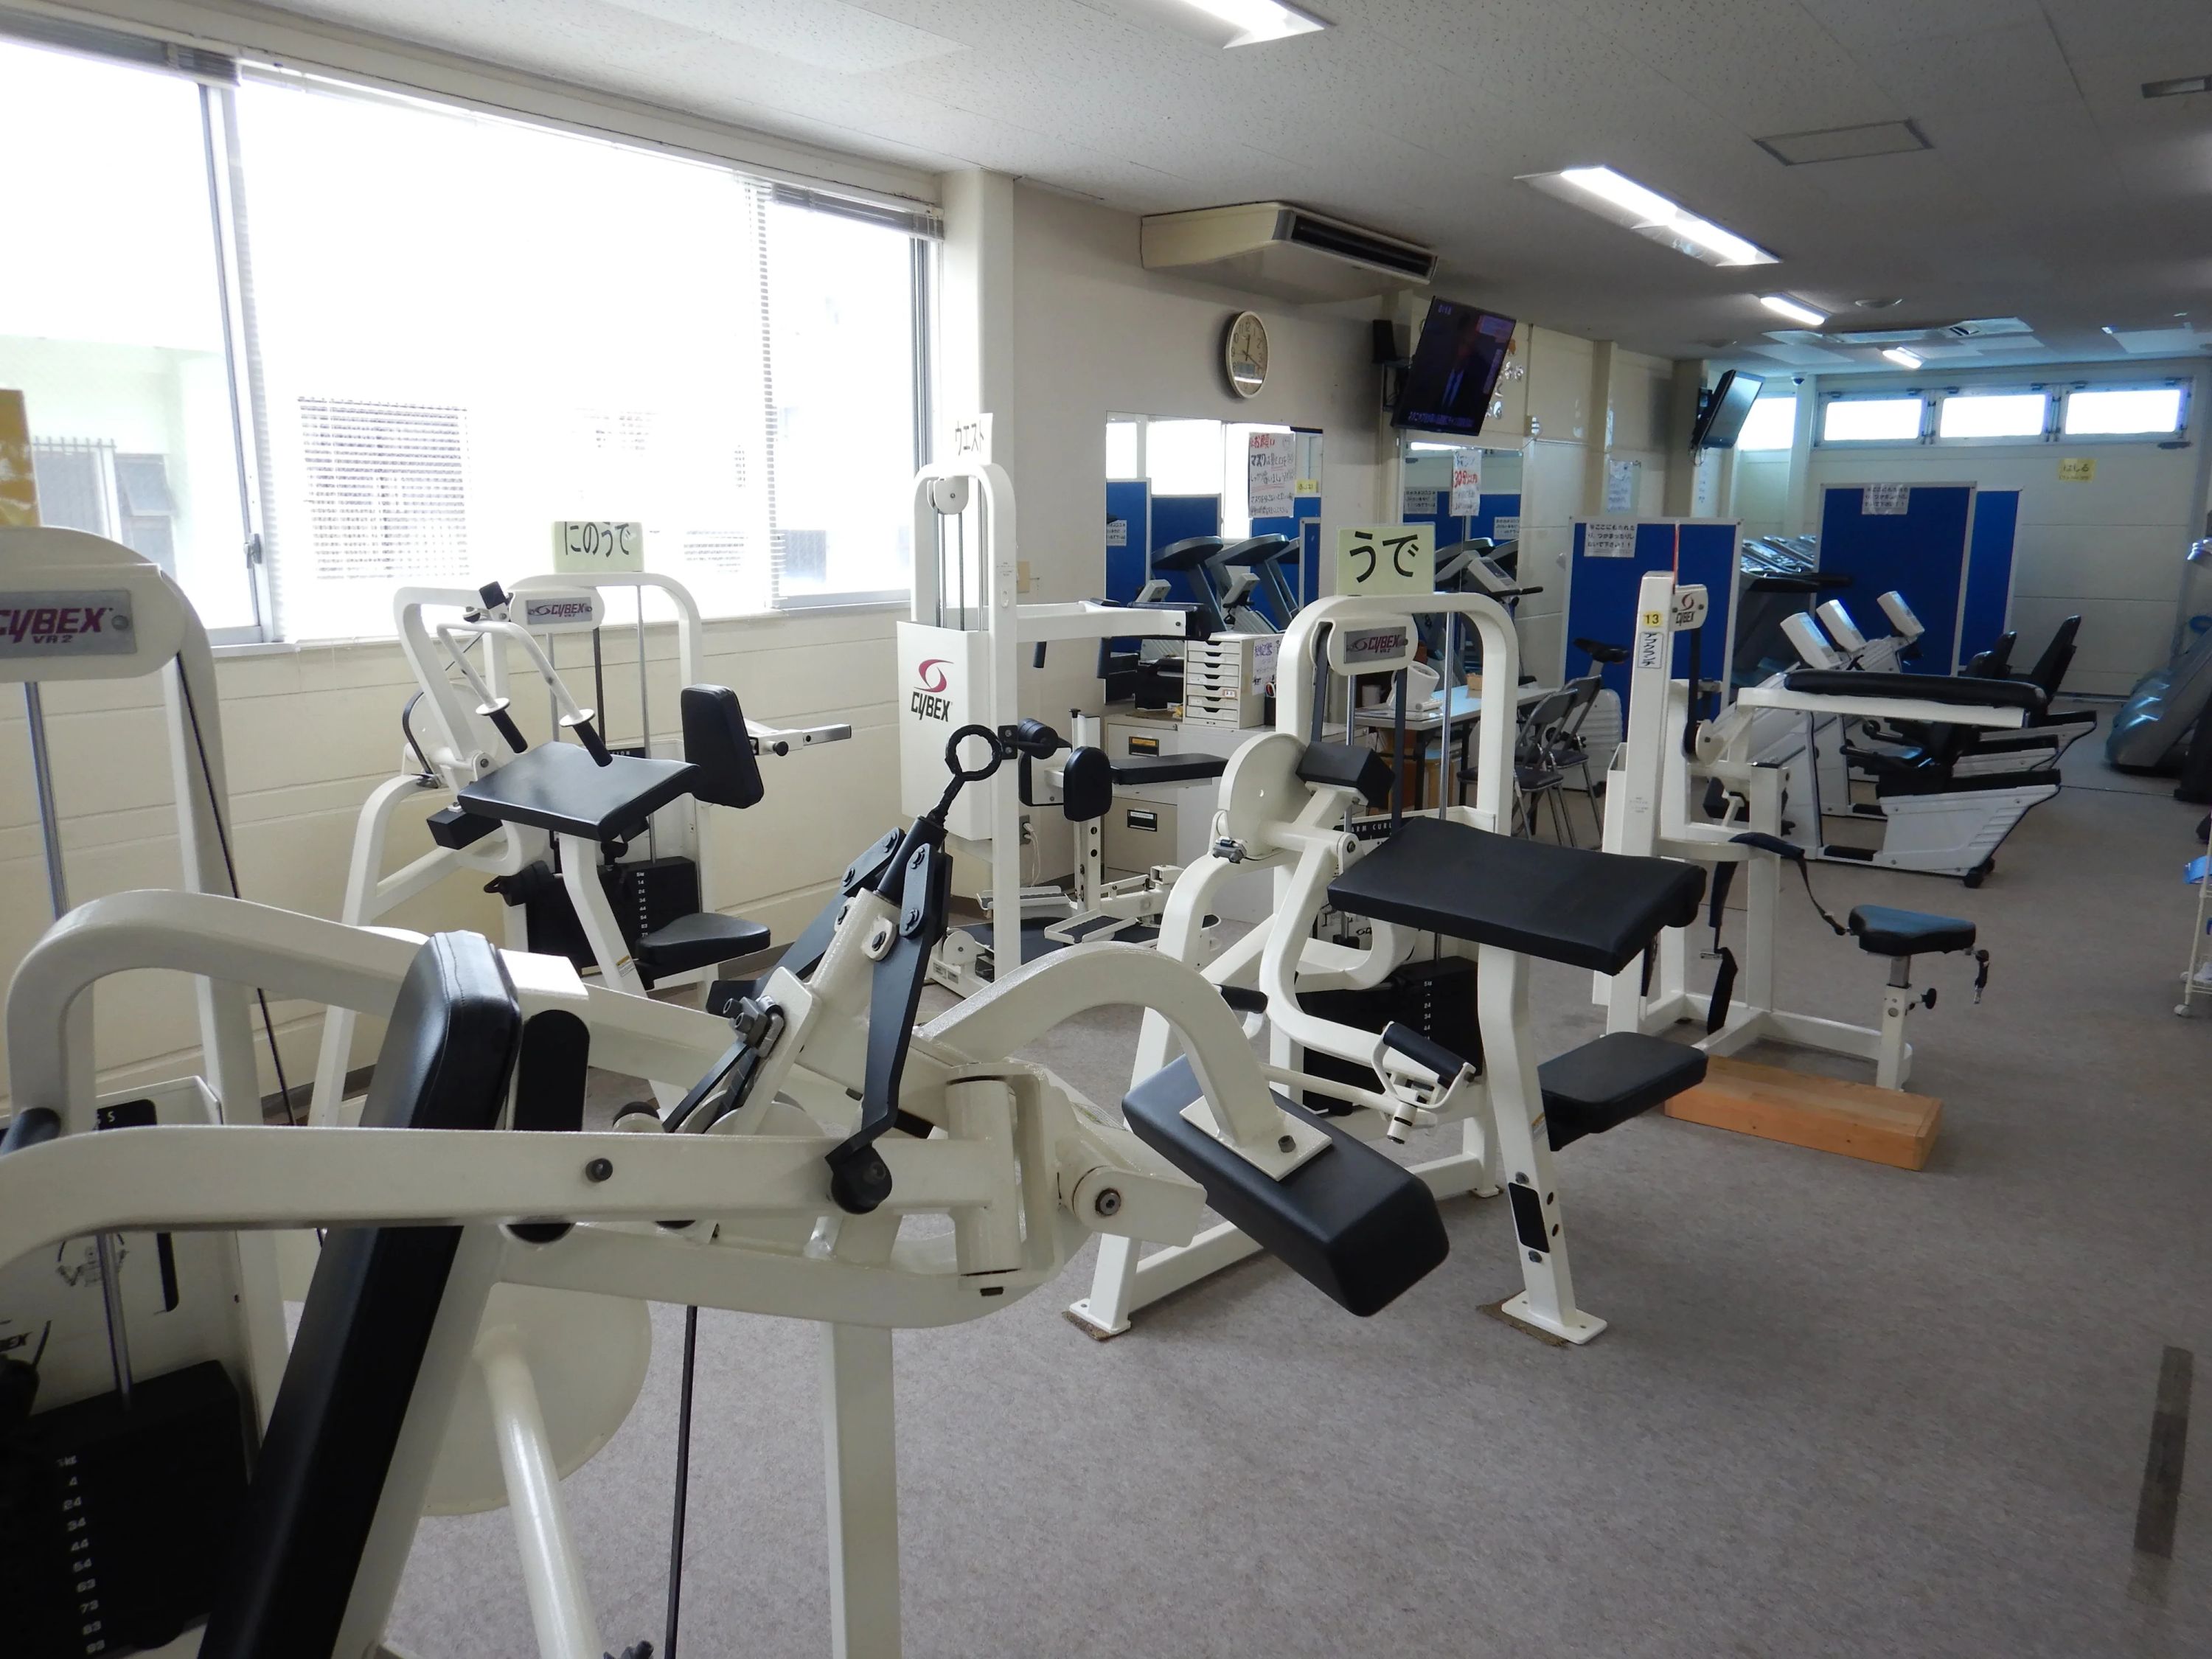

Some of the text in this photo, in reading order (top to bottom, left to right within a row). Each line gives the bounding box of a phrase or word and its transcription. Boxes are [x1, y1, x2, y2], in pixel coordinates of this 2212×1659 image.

[565, 521, 631, 557] にのうで
[1349, 531, 1419, 582] うで
[551, 603, 585, 617] CYBEX
[1646, 613, 1659, 624] 13
[1368, 635, 1400, 653] CYBEX
[911, 692, 950, 722] CYBEX
[67, 1517, 86, 1531] 34
[71, 1538, 88, 1552] 44
[72, 1558, 91, 1572] 54
[76, 1579, 96, 1593] 63
[80, 1599, 99, 1614] 73
